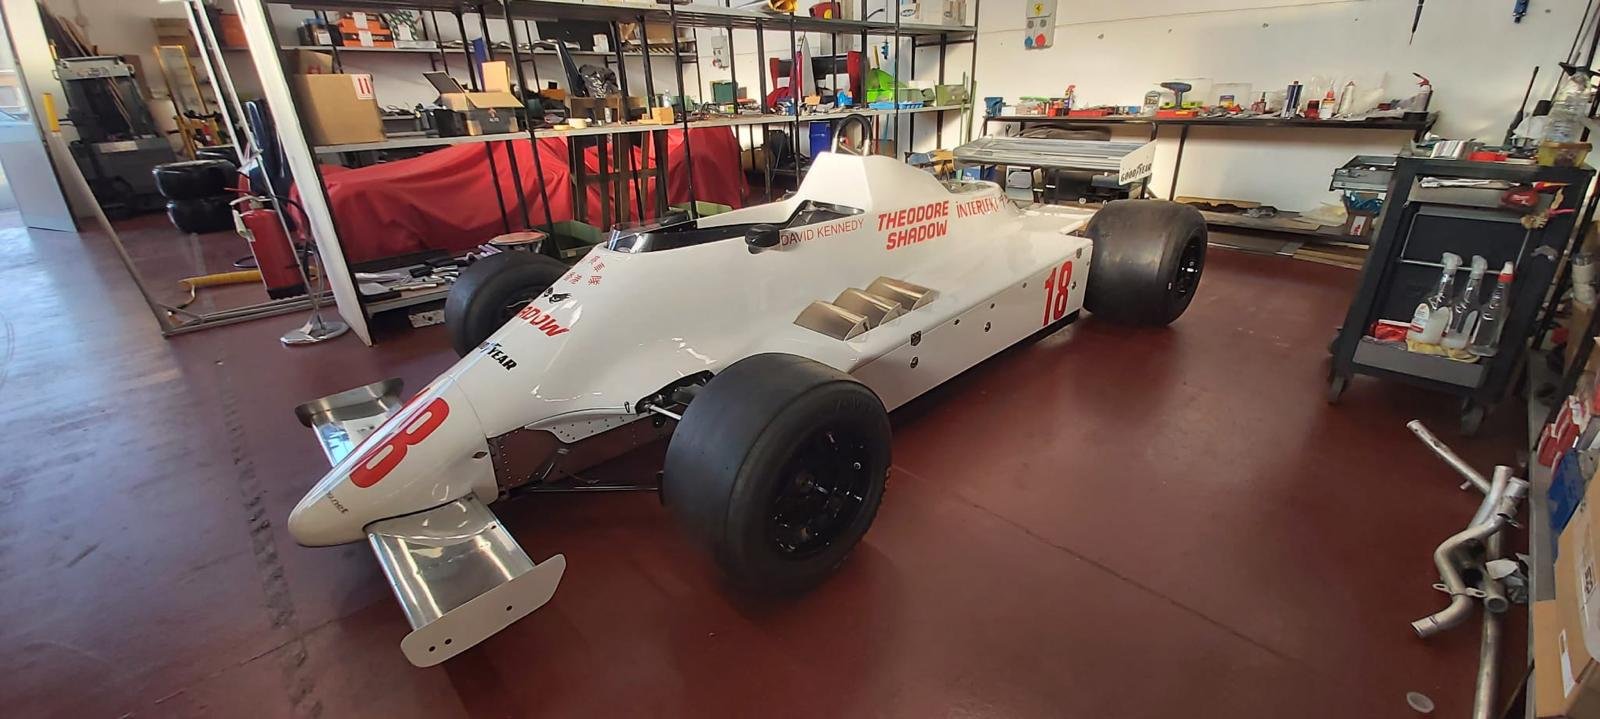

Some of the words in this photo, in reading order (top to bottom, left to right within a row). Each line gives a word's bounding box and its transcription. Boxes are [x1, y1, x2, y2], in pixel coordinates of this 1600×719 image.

[878, 201, 950, 232] THEODORE
[781, 229, 814, 246] DAVID
[817, 219, 865, 238] KENNEDY
[886, 221, 948, 251] SHADOW
[1043, 261, 1073, 326] 18
